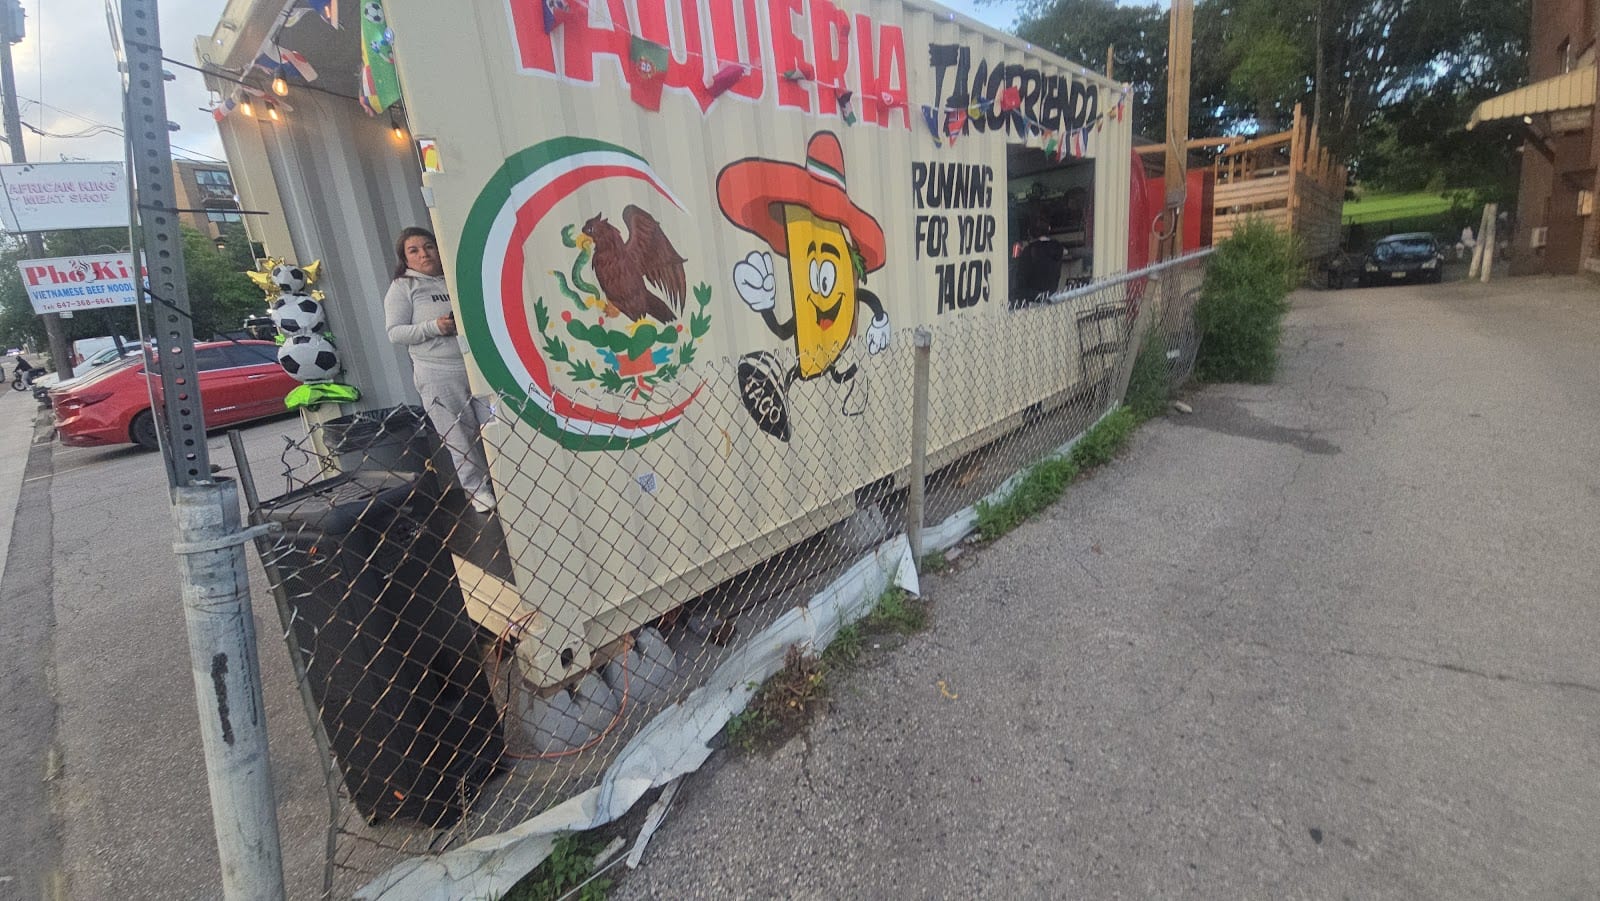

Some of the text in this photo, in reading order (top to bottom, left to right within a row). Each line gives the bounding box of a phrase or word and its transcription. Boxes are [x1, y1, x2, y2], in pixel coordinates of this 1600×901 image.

[9, 181, 117, 195] AFRICAN KING
[23, 193, 110, 206] MEAT SHOP
[912, 161, 993, 209] RUNNING
[915, 214, 995, 261] FOR YOUR
[32, 286, 85, 300] VIETNAMESE
[86, 285, 105, 295] BEEF
[107, 282, 136, 293] NOODL
[935, 259, 992, 315] TACOS
[744, 377, 780, 424] TACO
